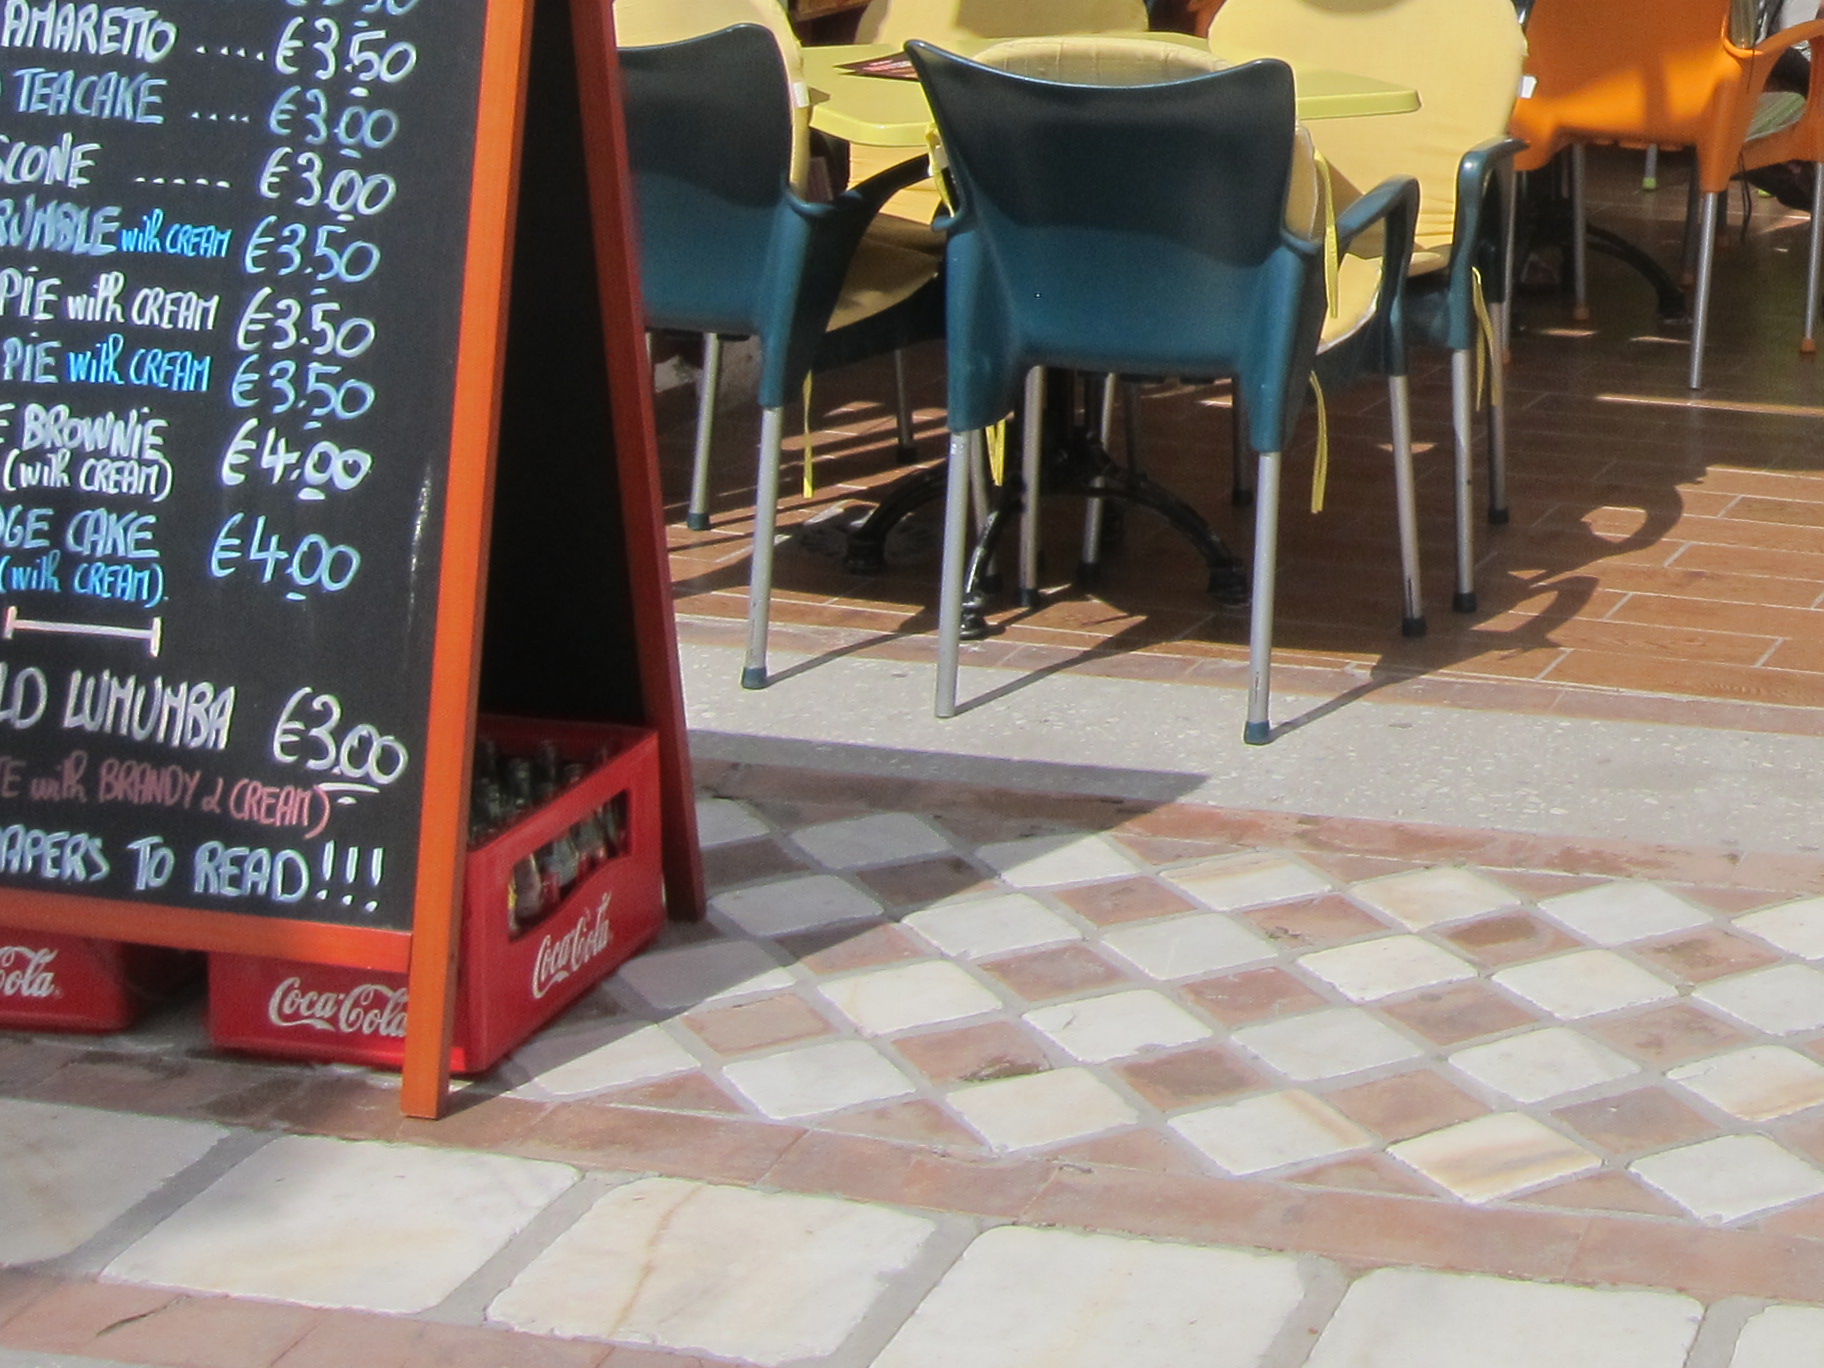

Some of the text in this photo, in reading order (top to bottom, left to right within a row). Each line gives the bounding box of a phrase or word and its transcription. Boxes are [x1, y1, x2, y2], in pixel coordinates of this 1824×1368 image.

[275, 16, 418, 83] €3.50
[12, 67, 400, 148] TEACAKE €3.00
[0, 132, 397, 214] CONE €3.00
[120, 208, 165, 253] with
[165, 222, 232, 258] CREAM
[245, 215, 380, 283] €3.50
[67, 271, 125, 323] with
[131, 287, 220, 331] CREAM
[236, 287, 376, 358] €3.50
[3, 332, 376, 419] PIE with CREAM €3.50
[3, 448, 173, 502] (with CREAM)
[0, 504, 54, 550] GE
[66, 507, 160, 559] CAKE
[0, 549, 61, 593] (with
[62, 668, 236, 750] LUMUMBA
[272, 687, 409, 784] €3.00
[30, 749, 88, 803] with
[99, 757, 202, 810] BRANDY
[127, 835, 176, 891] TO
[532, 892, 612, 999] Coca-Cola
